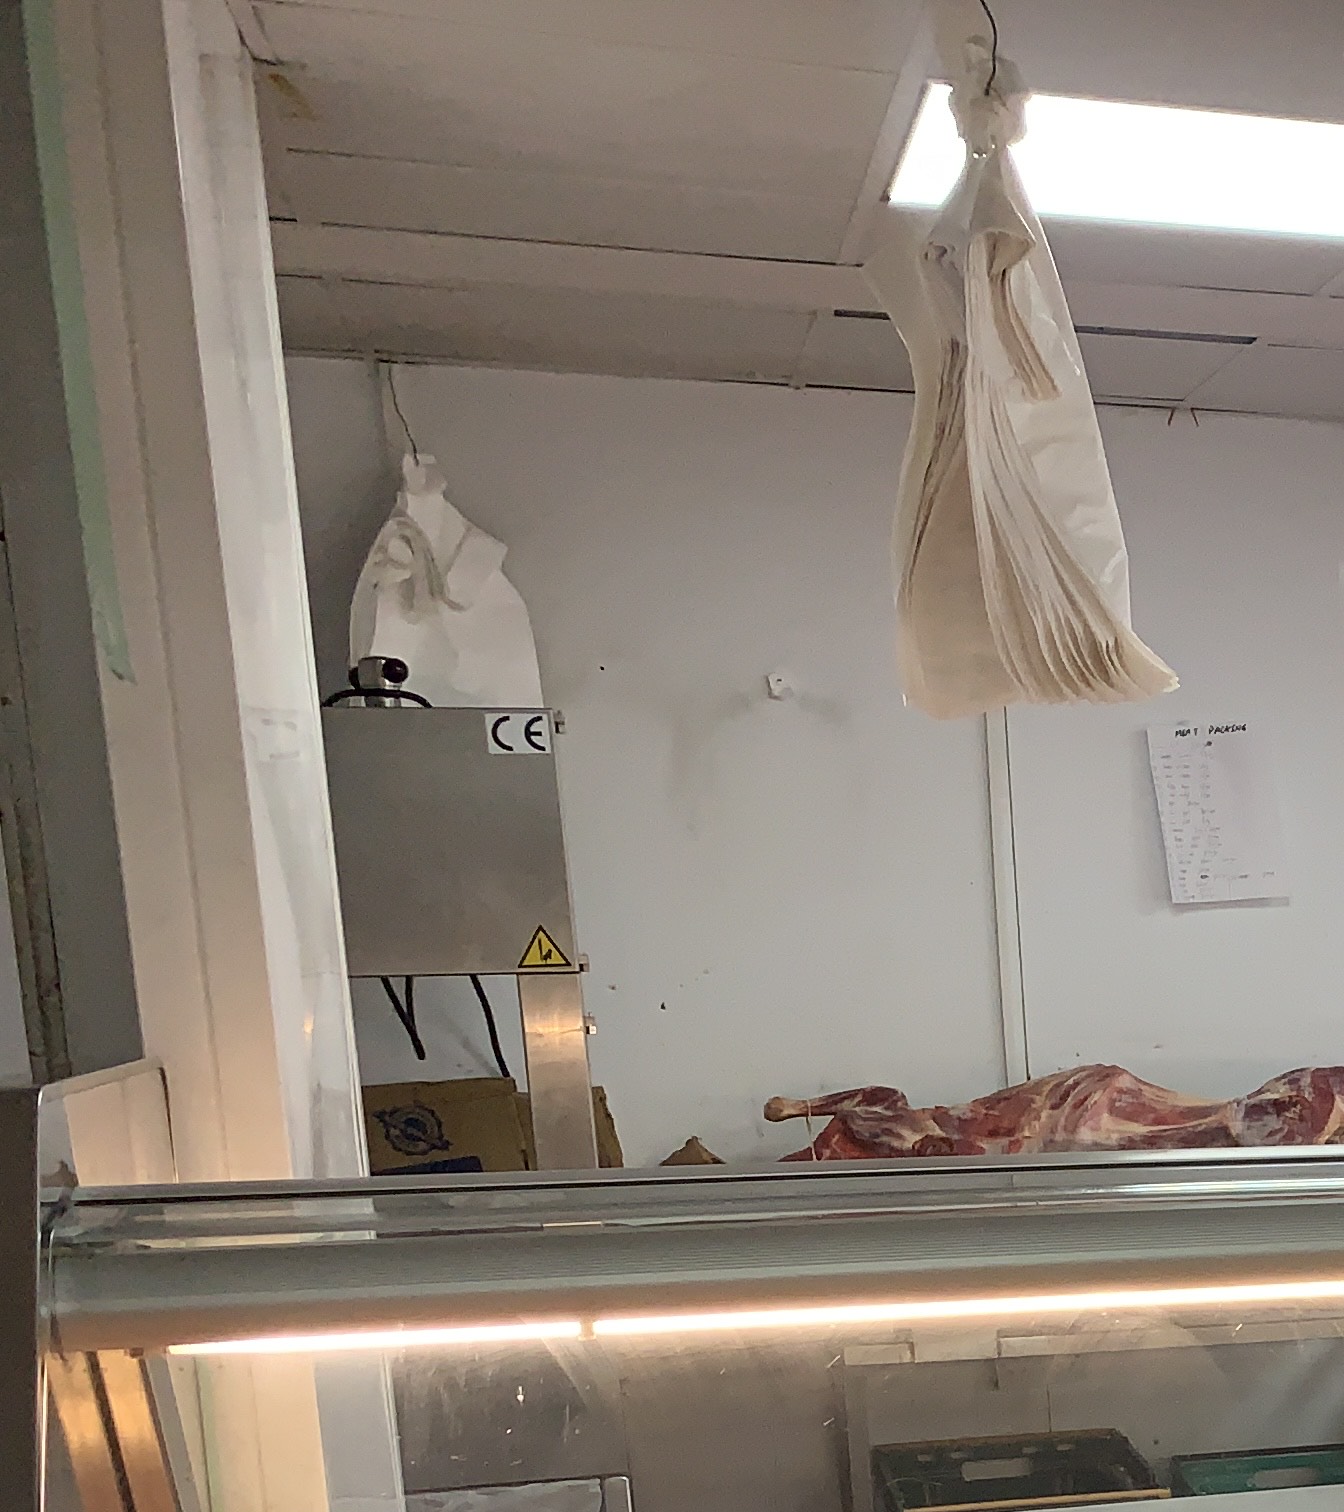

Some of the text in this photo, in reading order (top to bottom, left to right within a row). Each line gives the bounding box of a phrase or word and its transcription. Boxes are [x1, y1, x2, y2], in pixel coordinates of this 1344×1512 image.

[491, 715, 546, 752] CE
[1175, 723, 1247, 738] MEAT PACKING
